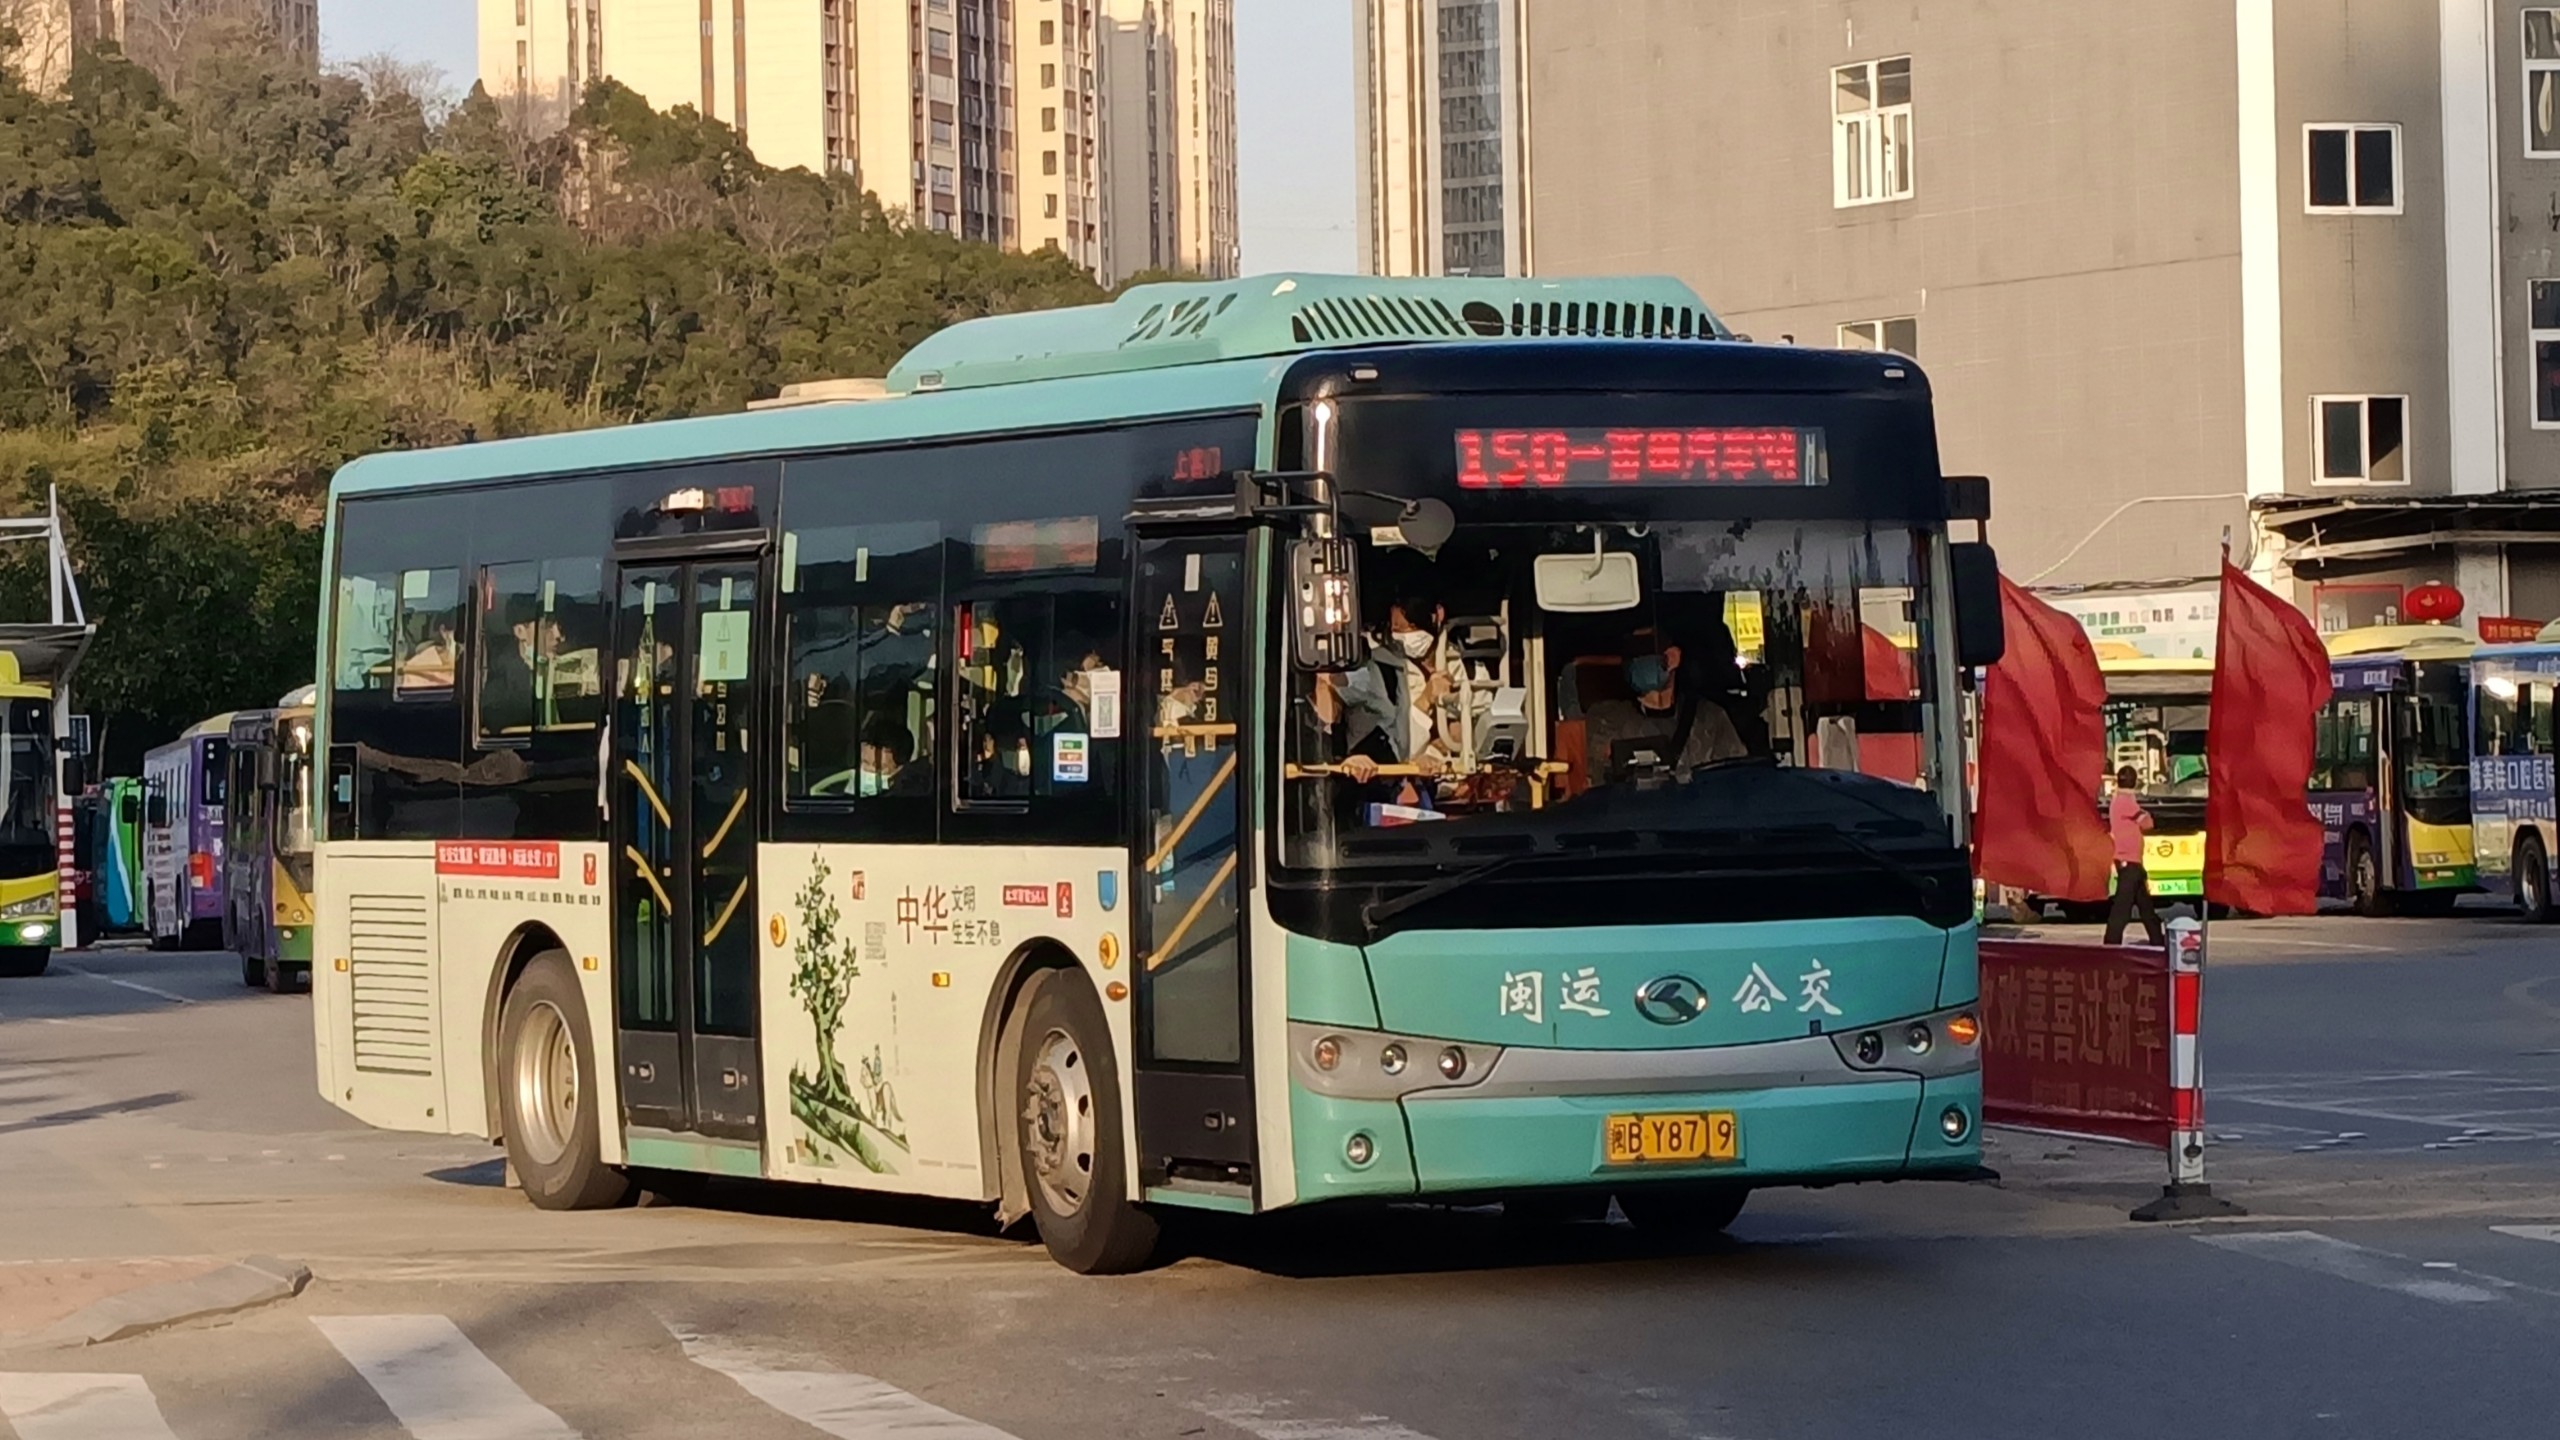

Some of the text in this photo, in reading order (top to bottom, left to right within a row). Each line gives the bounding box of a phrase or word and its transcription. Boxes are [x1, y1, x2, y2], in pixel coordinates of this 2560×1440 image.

[897, 885, 949, 944] 中华
[951, 886, 976, 912] 文明
[952, 919, 1001, 945] 生生不息
[1500, 958, 1843, 1024] 闽运 公交
